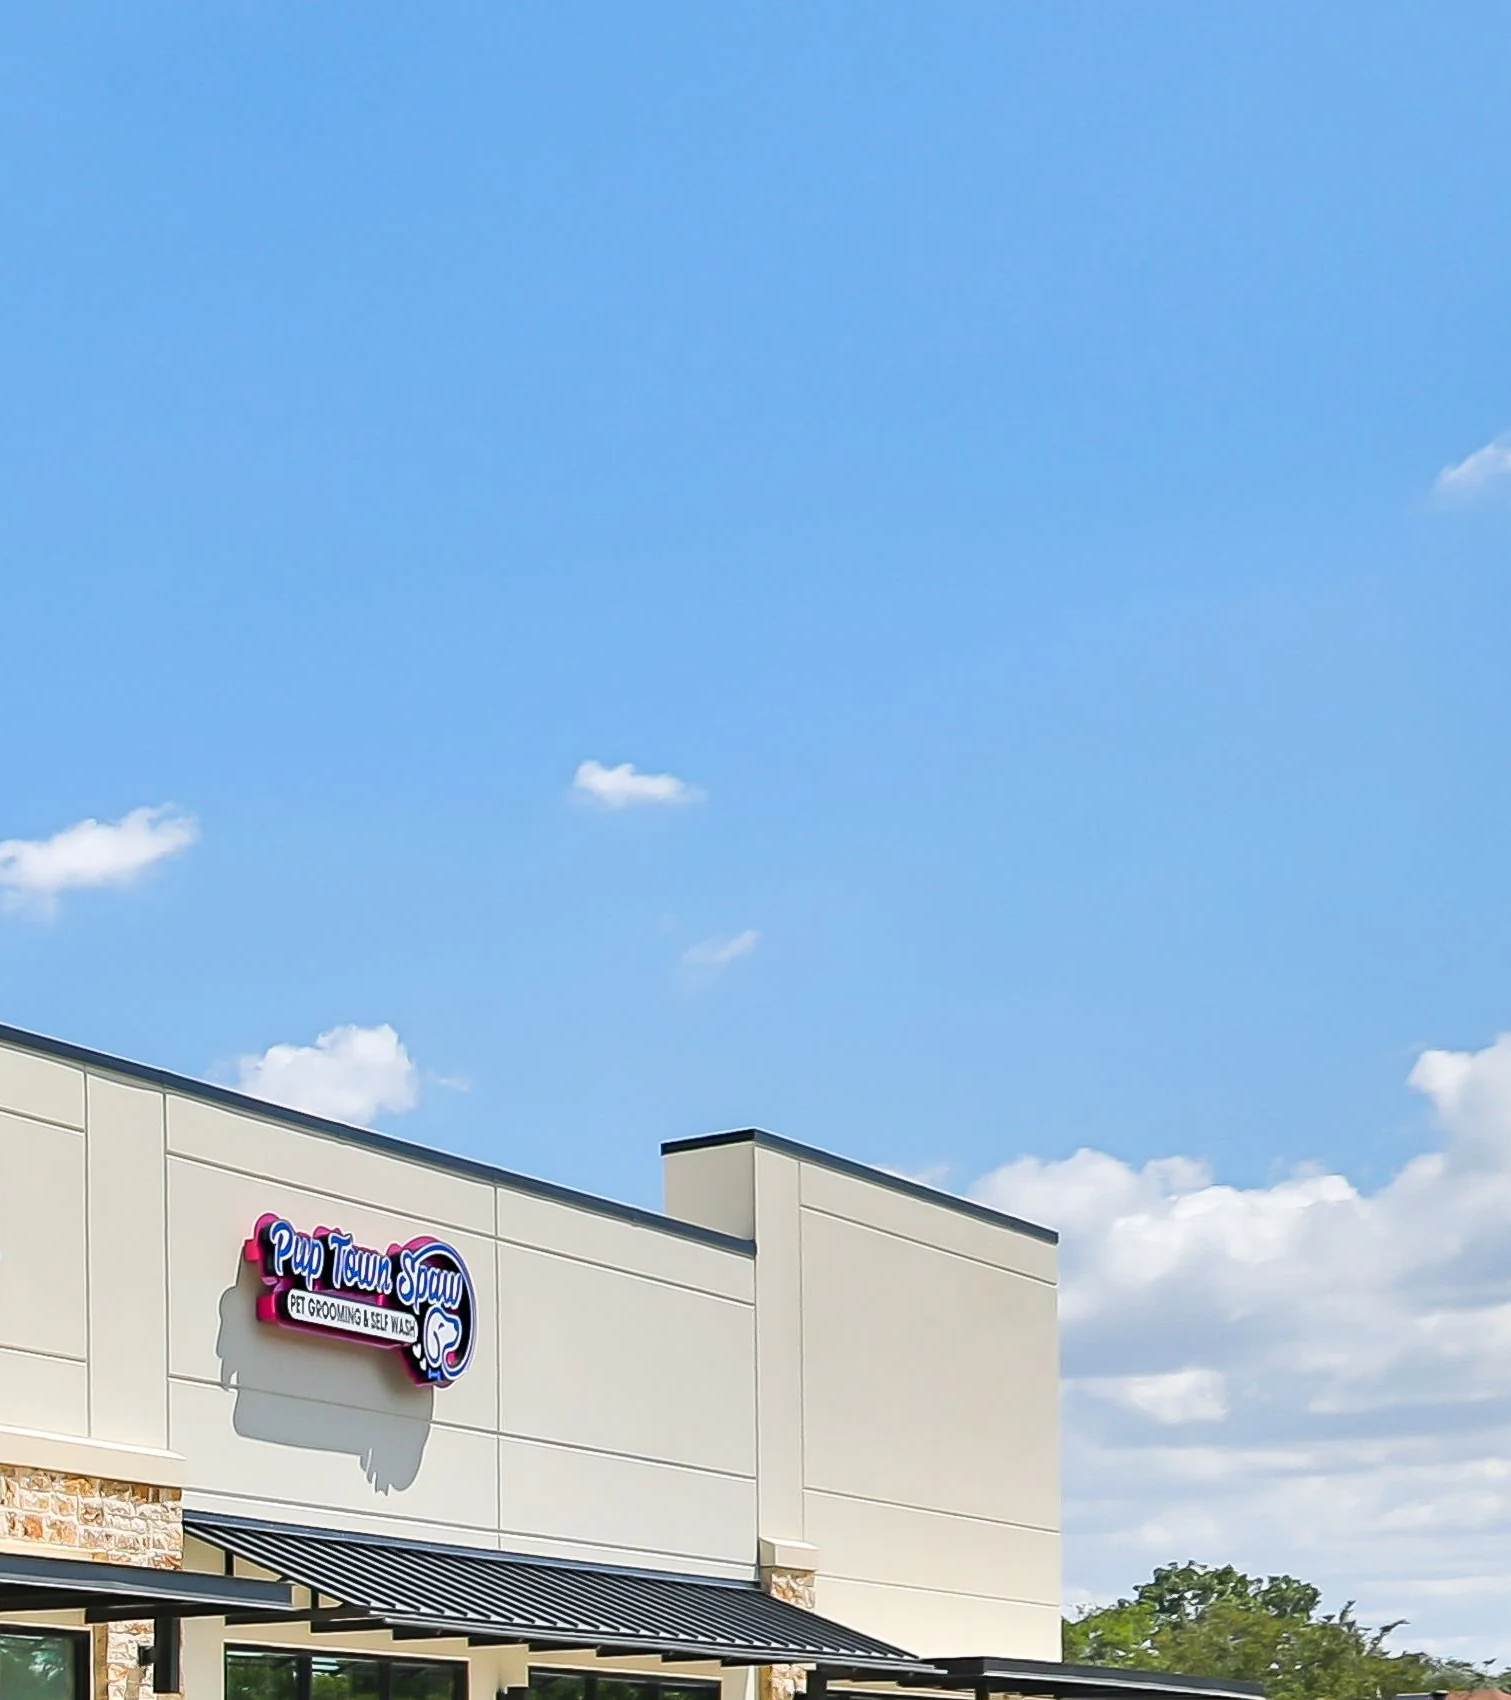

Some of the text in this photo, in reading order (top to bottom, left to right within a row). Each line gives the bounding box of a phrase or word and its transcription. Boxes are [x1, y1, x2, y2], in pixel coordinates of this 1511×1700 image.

[270, 1220, 464, 1314] Pup Town Spaw
[290, 1293, 305, 1315] PET
[308, 1297, 361, 1327] GROOMING
[370, 1310, 389, 1332] SELF
[390, 1315, 417, 1339] WASH
